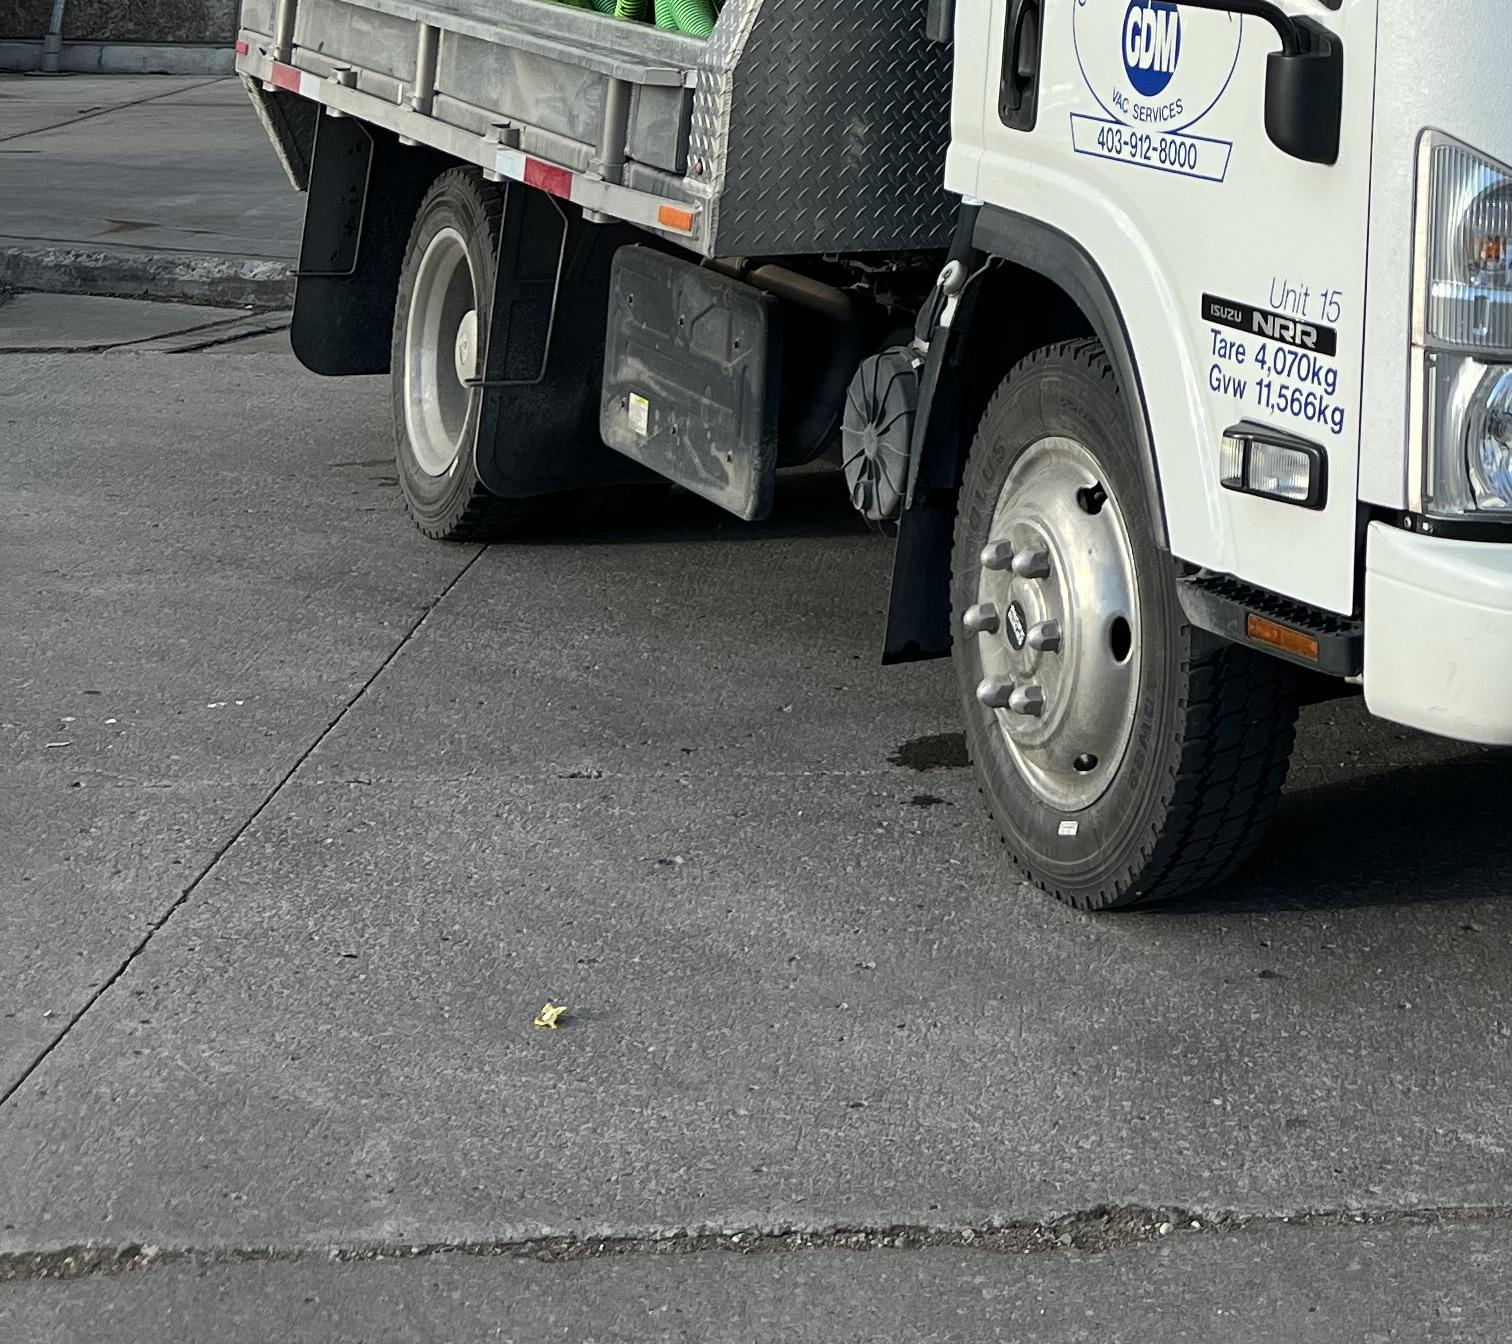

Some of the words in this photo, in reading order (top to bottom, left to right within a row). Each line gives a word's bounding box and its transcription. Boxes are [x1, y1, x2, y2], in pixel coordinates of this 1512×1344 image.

[1125, 5, 1179, 73] GDM
[1112, 86, 1129, 113] VAC
[1132, 98, 1184, 123] SERVICES
[1097, 126, 1198, 170] 403-912-8000
[1270, 276, 1310, 316] Unit
[1321, 289, 1343, 323] 15
[1210, 303, 1242, 322] ISUZU
[1252, 311, 1317, 349] NRR
[1210, 328, 1246, 364] Tare
[1255, 343, 1338, 396] 4,070kg
[1209, 363, 1247, 399] Gvw
[1256, 378, 1345, 435] 11,566kg
